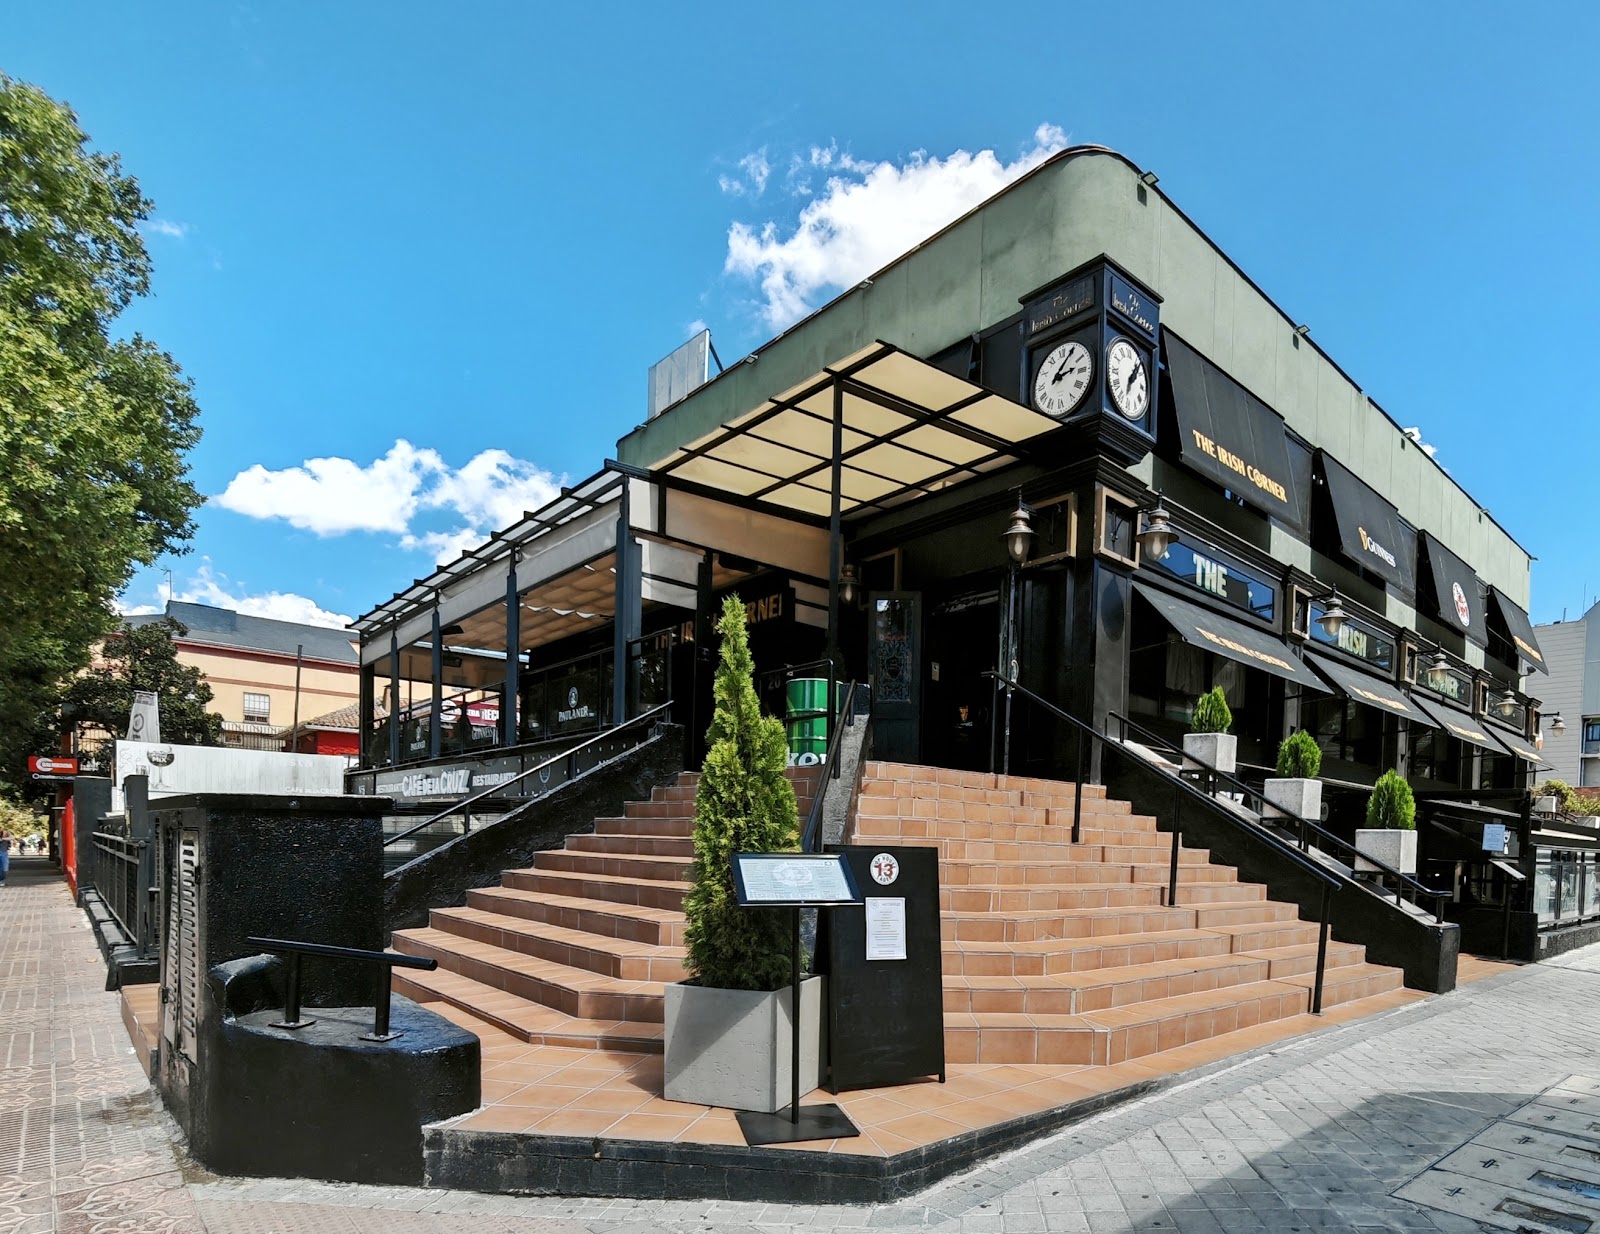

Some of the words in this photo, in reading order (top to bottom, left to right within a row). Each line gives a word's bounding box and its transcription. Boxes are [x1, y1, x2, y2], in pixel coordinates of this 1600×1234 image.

[1193, 429, 1217, 459] THE
[1217, 445, 1246, 477] IRISH
[1247, 465, 1288, 503] CORNER
[1367, 536, 1397, 568] GUINNESS
[1193, 553, 1228, 598] THE
[746, 593, 783, 625] RNE
[1338, 623, 1367, 658] IRISH
[558, 705, 588, 722] PAULANER
[440, 769, 470, 795] CRUZ
[876, 862, 893, 877] 13
